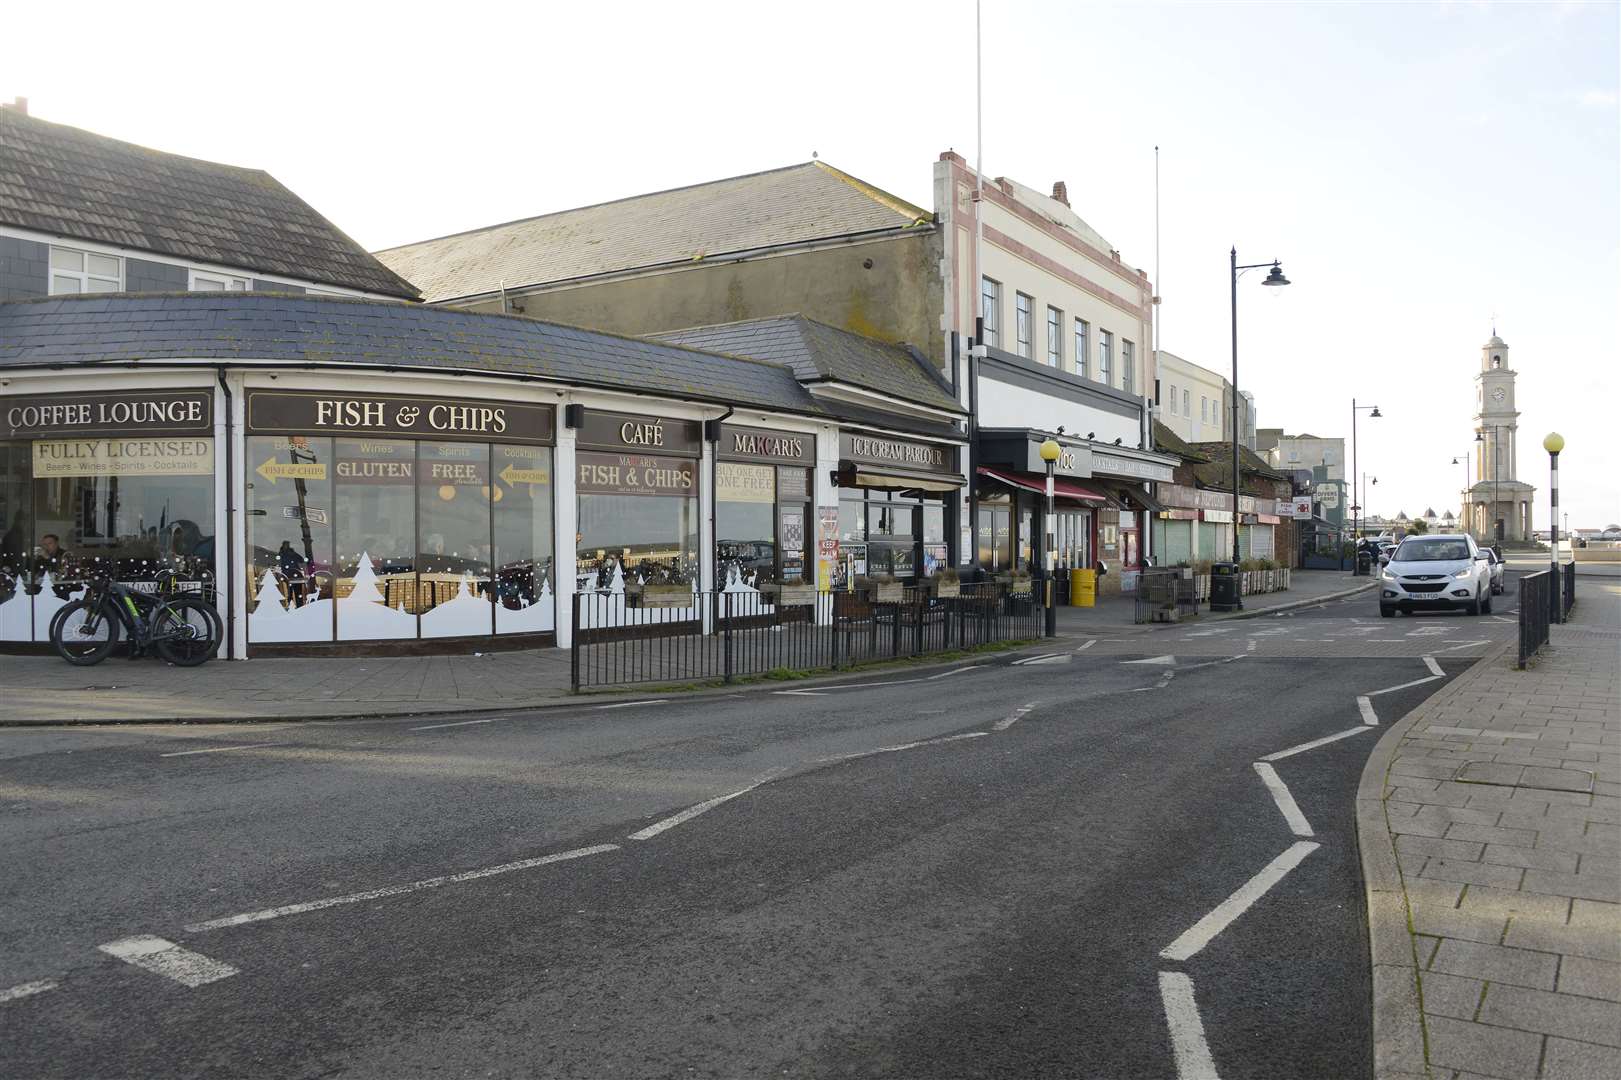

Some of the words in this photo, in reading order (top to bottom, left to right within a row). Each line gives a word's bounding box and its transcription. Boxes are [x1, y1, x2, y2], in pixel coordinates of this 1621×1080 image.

[7, 404, 92, 428] COFFEE
[99, 401, 202, 423] LOUNGE
[315, 400, 386, 428] FISH
[395, 406, 420, 427] &
[428, 404, 507, 433] CHIPS
[620, 418, 664, 447] CAFÉ
[39, 442, 101, 459] FULLY
[106, 441, 207, 458] LICENSED
[851, 437, 870, 456] ICE
[871, 440, 903, 460] CREAM
[904, 445, 943, 465] PARLOUR
[45, 462, 72, 472] Beers
[79, 462, 107, 471] Wines
[115, 461, 146, 471] Spirits
[153, 460, 199, 470] Cocktails
[335, 462, 412, 478] GLUTEN
[431, 463, 477, 479] FREE
[579, 463, 621, 486] FISH
[626, 467, 639, 486] &
[644, 468, 692, 488] CHIPS
[743, 478, 773, 489] FREE
